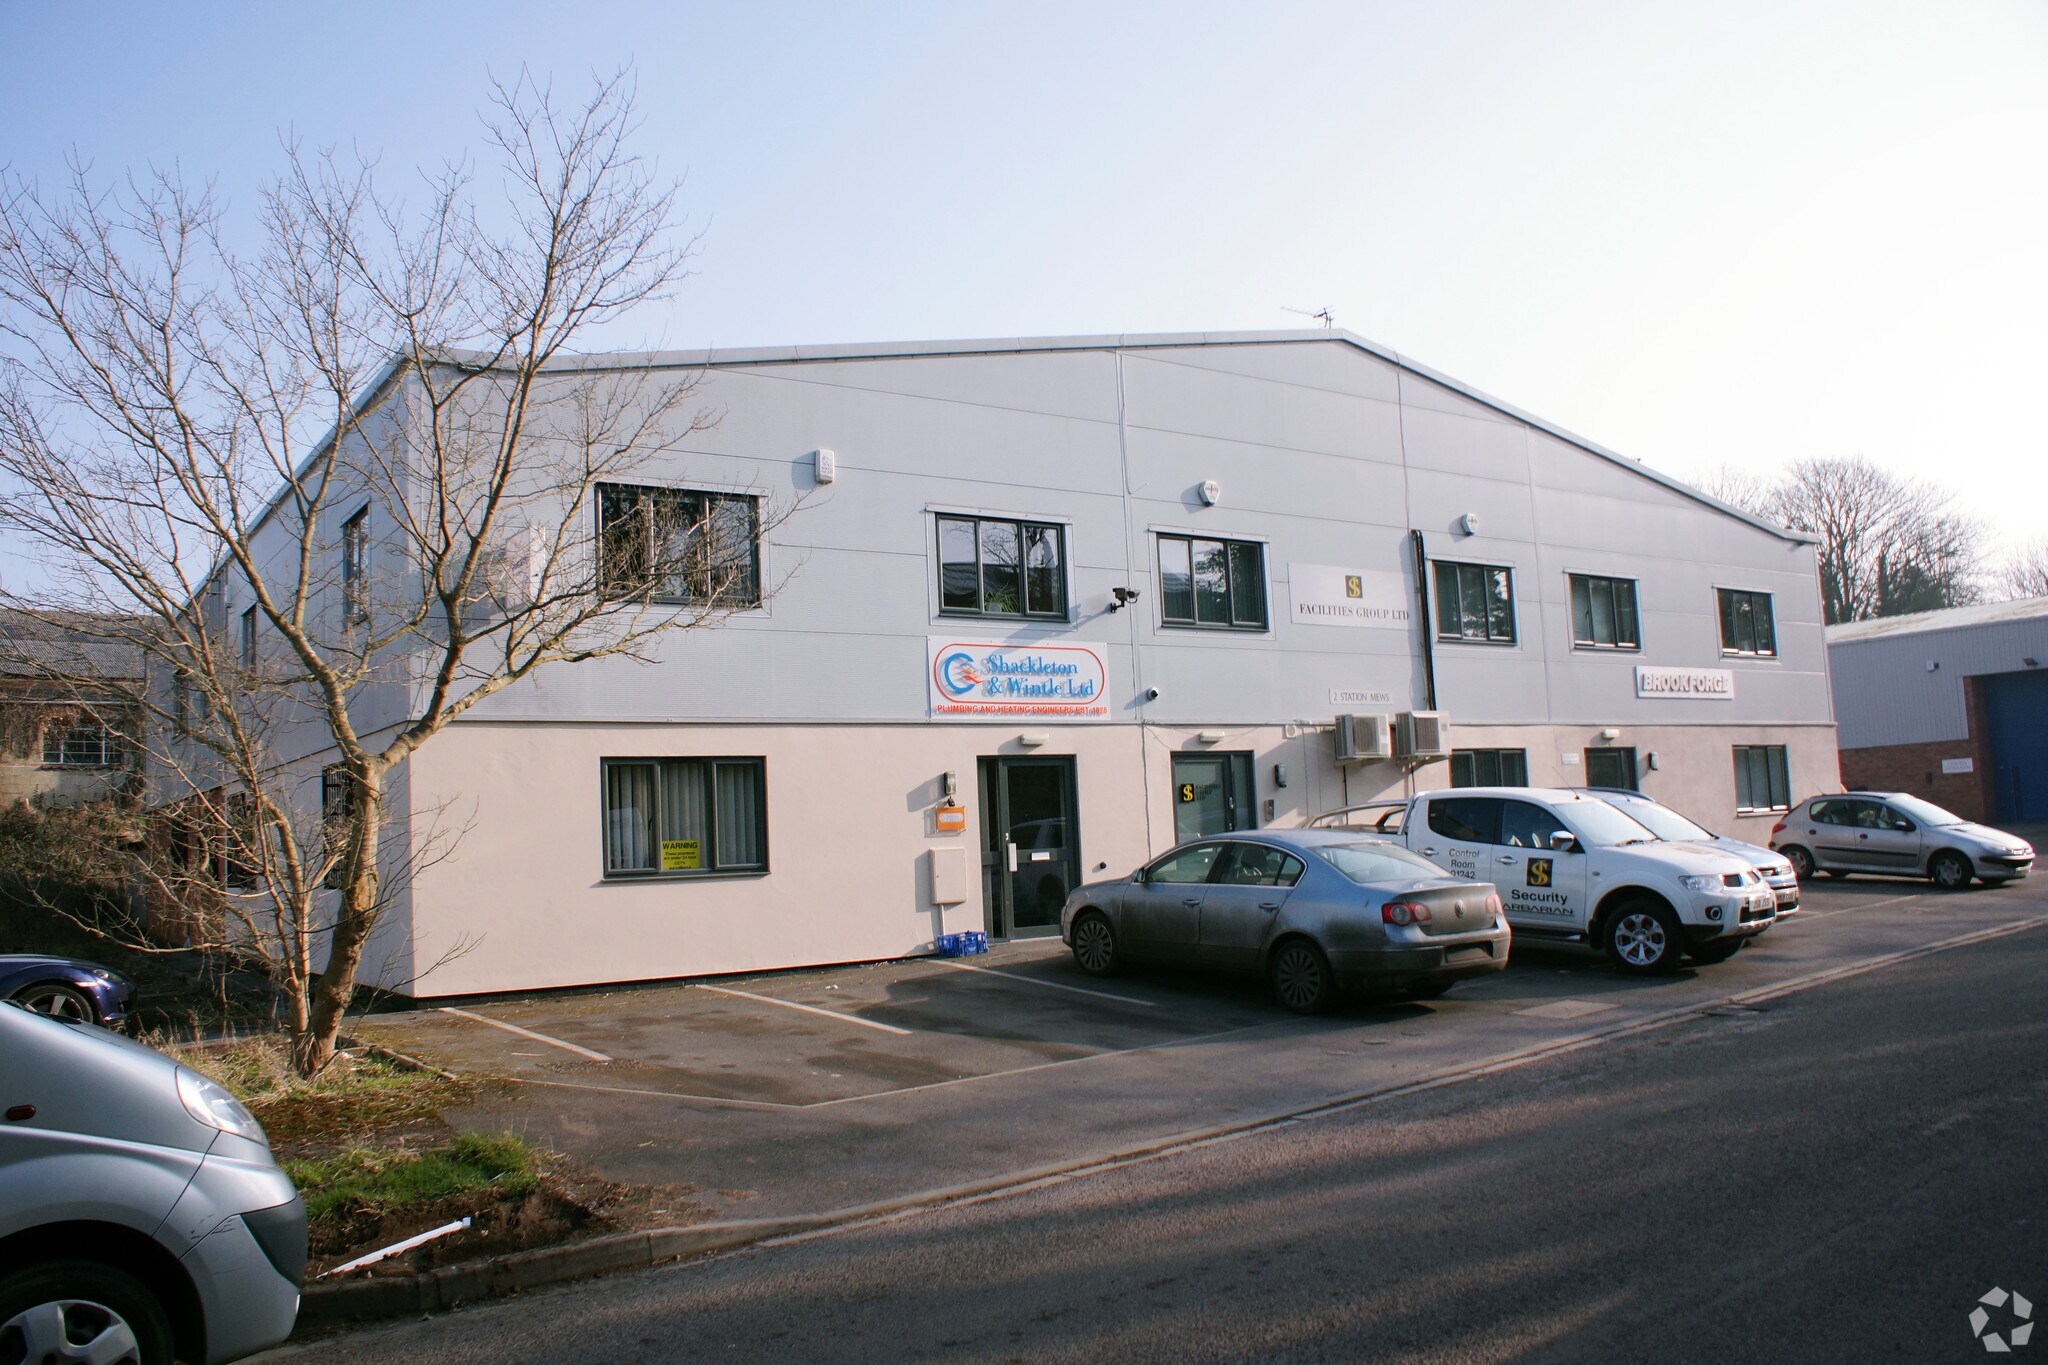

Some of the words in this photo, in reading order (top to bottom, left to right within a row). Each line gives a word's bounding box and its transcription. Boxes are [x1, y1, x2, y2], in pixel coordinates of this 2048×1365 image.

[1299, 603, 1353, 617] FACILITIES
[1356, 607, 1389, 619] GROUP
[1392, 609, 1409, 620] LTD
[987, 654, 1078, 675] Shackleton
[989, 677, 1002, 694] &
[1008, 677, 1062, 696] Wintle
[1067, 678, 1094, 696] Ltd
[1642, 673, 1691, 693] BROOK
[1691, 674, 1728, 693] FORGE
[1333, 692, 1338, 701] 2
[1340, 692, 1368, 702] STATION
[1370, 692, 1390, 702] MEWS
[937, 705, 978, 713] PLUMBING
[980, 705, 996, 713] AND
[998, 705, 1030, 714] HEATING
[1032, 706, 1074, 714] ENGINEERS
[1448, 848, 1480, 858] Control
[1451, 859, 1475, 869] Room
[1511, 889, 1568, 906] Security
[1502, 902, 1575, 915] ARBARIAN
